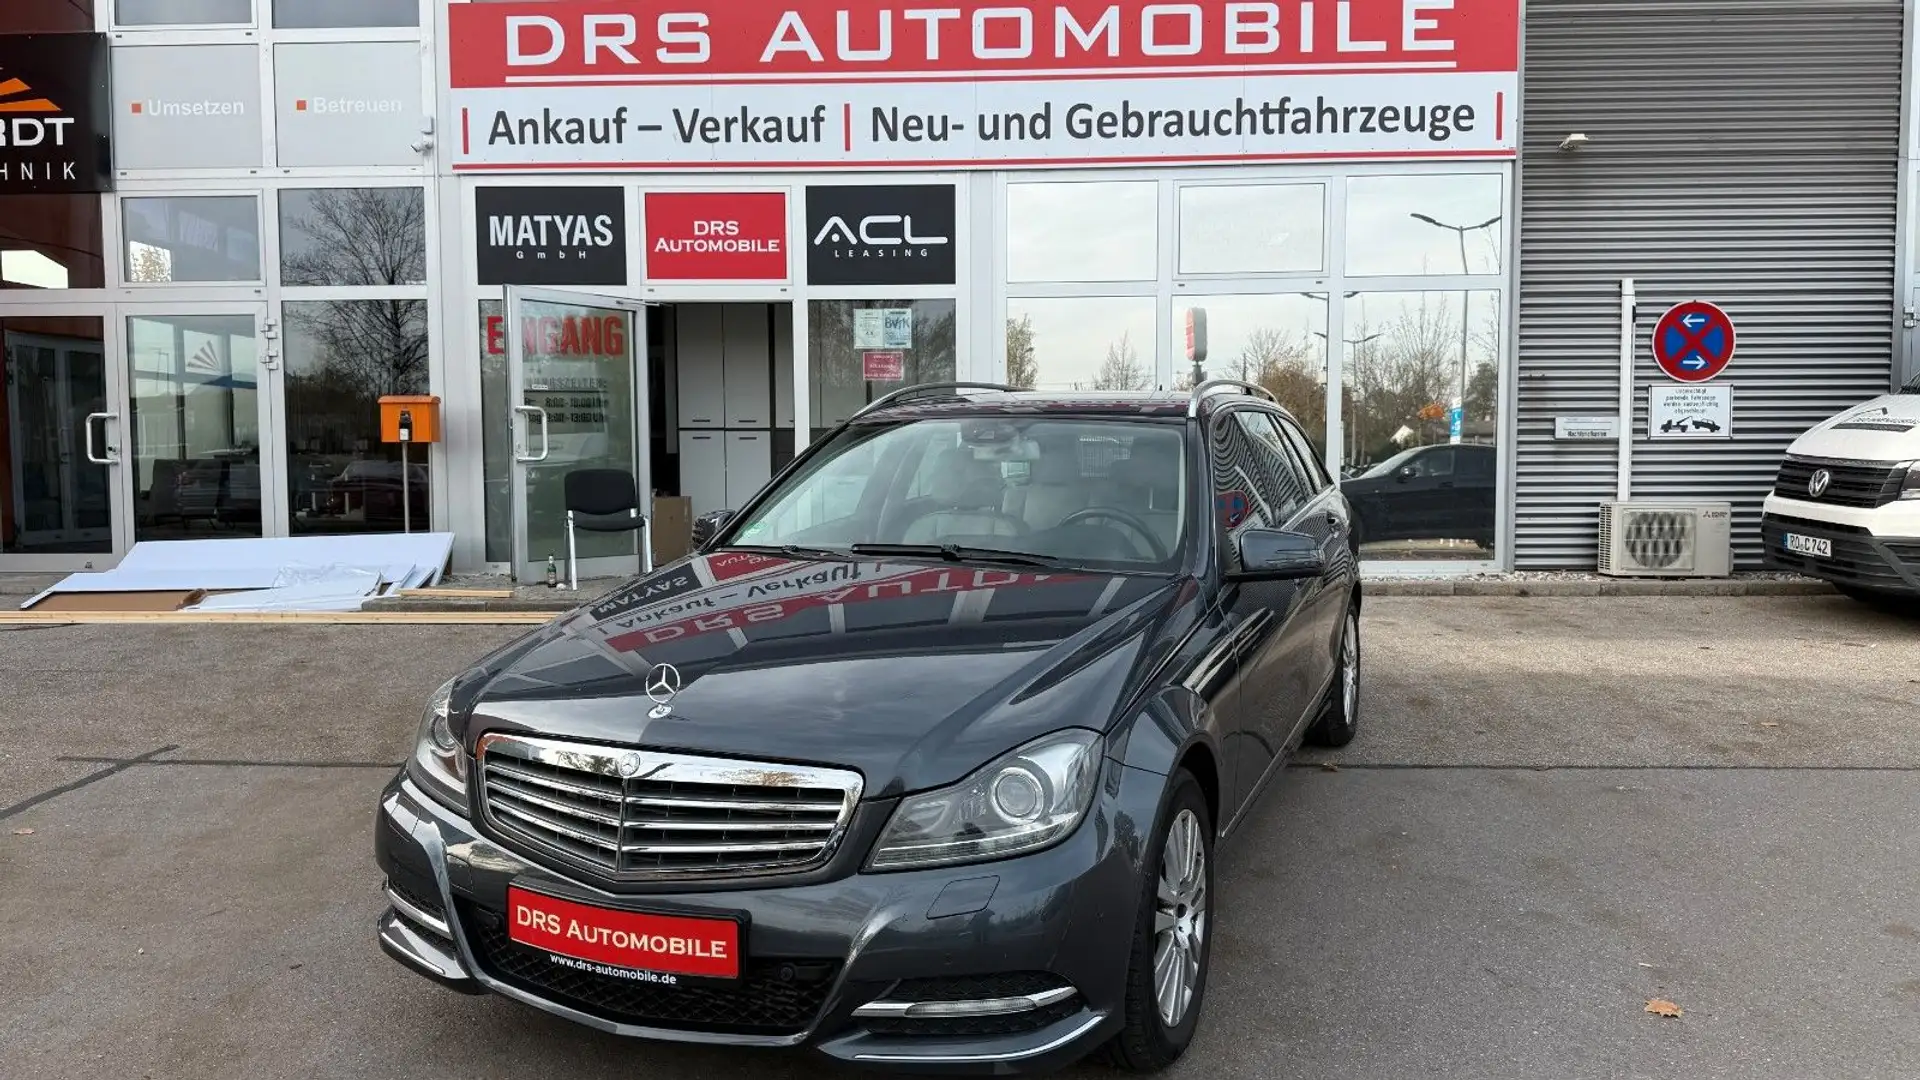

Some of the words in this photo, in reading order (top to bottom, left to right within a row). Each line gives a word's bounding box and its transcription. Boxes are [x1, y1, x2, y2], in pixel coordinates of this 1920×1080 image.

[505, 12, 710, 66] DRS
[758, 0, 1455, 63] AUTOMOBILE
[148, 98, 245, 118] Umsetzen
[313, 96, 402, 115] Betreuen
[0, 117, 74, 147] DT
[488, 107, 627, 146] Ankauf
[672, 105, 825, 144] Verkauf
[872, 106, 964, 142] Neu-
[977, 102, 1051, 141] und
[1065, 97, 1475, 142] Gebrauchtfahrzeuge
[489, 214, 613, 246] MATYAS
[693, 220, 739, 236] DRS
[813, 215, 949, 245] ACL
[654, 237, 780, 253] AUTOMOBILE
[834, 249, 928, 258] LEASING
[486, 315, 624, 356] ENGANG
[517, 906, 561, 934] DRS
[566, 919, 727, 959] AUTOMOBILE
[550, 953, 677, 985] www.drs-automobile.de
